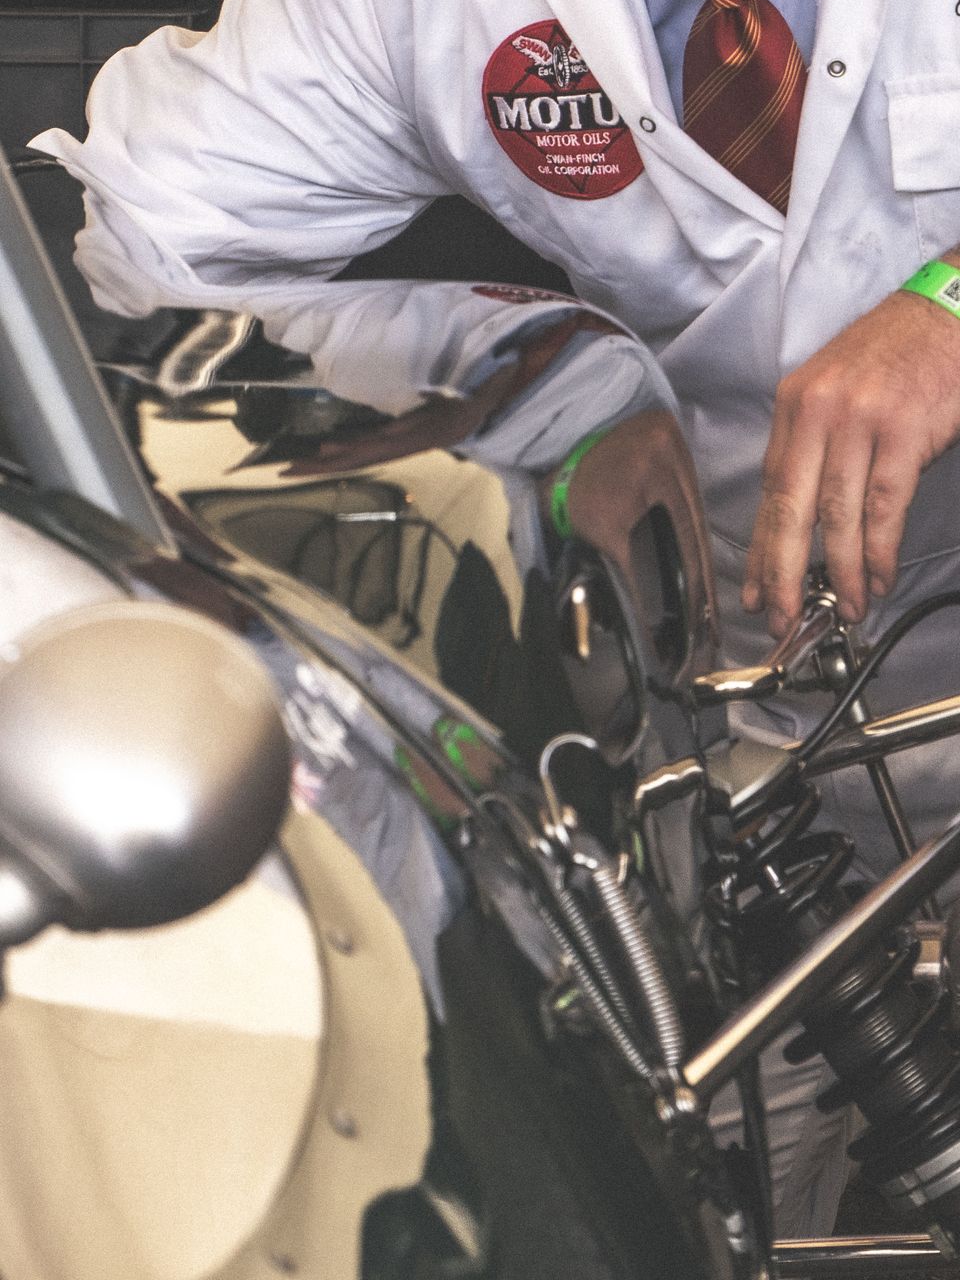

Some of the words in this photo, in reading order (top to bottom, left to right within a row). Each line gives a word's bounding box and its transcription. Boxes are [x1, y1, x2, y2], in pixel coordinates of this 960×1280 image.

[519, 38, 552, 62] SWAN
[492, 92, 621, 132] MOTU
[536, 134, 580, 147] MOTOR
[582, 132, 611, 146] OILS
[545, 153, 606, 165] SWAN-FINCH
[537, 165, 552, 175] OIL
[554, 164, 621, 176] CORPORATION
